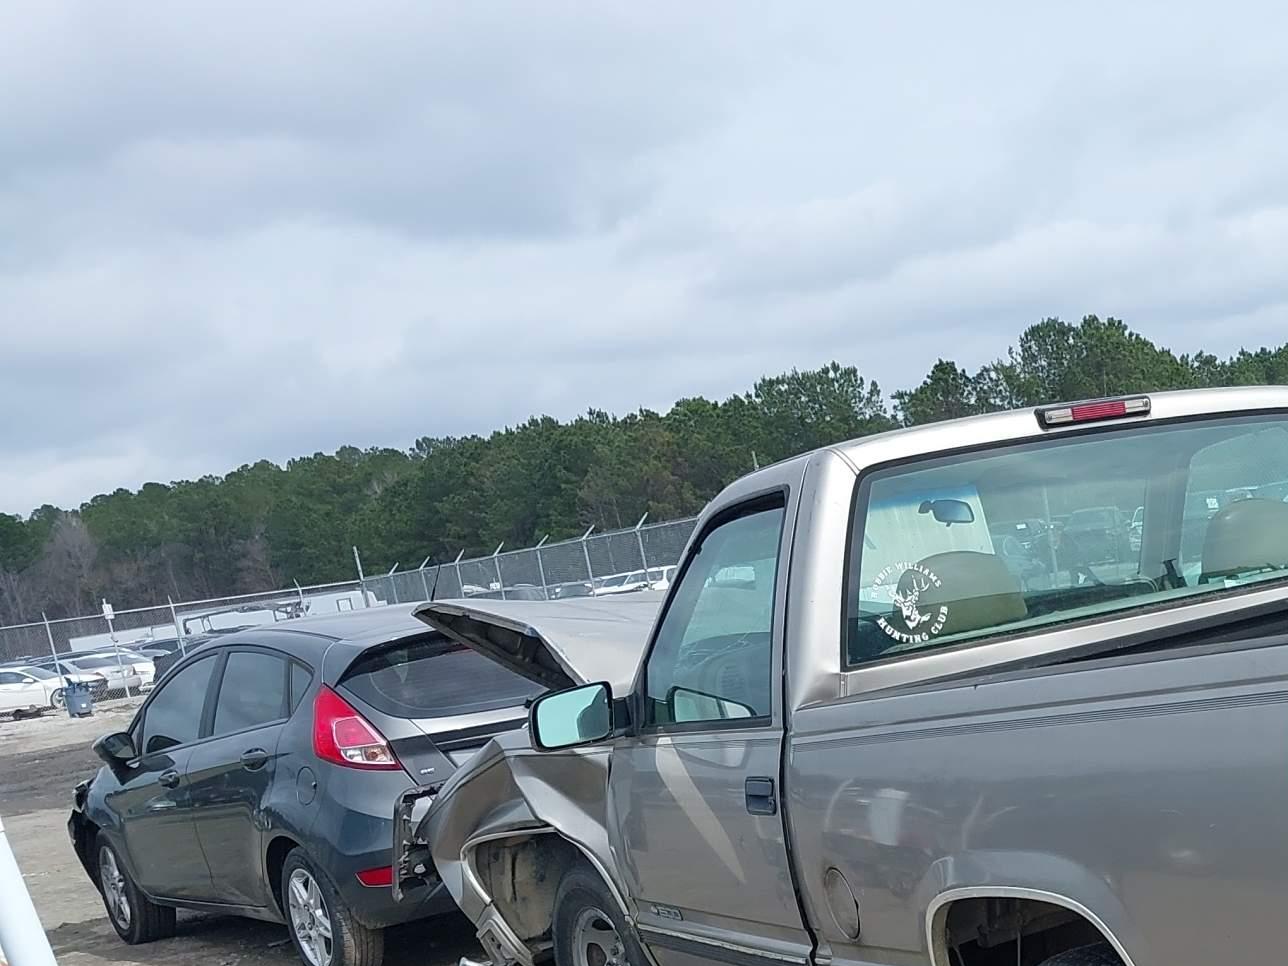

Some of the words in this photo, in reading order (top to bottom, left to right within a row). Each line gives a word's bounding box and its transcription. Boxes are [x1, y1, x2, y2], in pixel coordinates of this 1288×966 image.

[894, 561, 942, 588] WILLIAMS
[876, 617, 929, 643] HUNTING
[930, 605, 949, 635] CLUB
